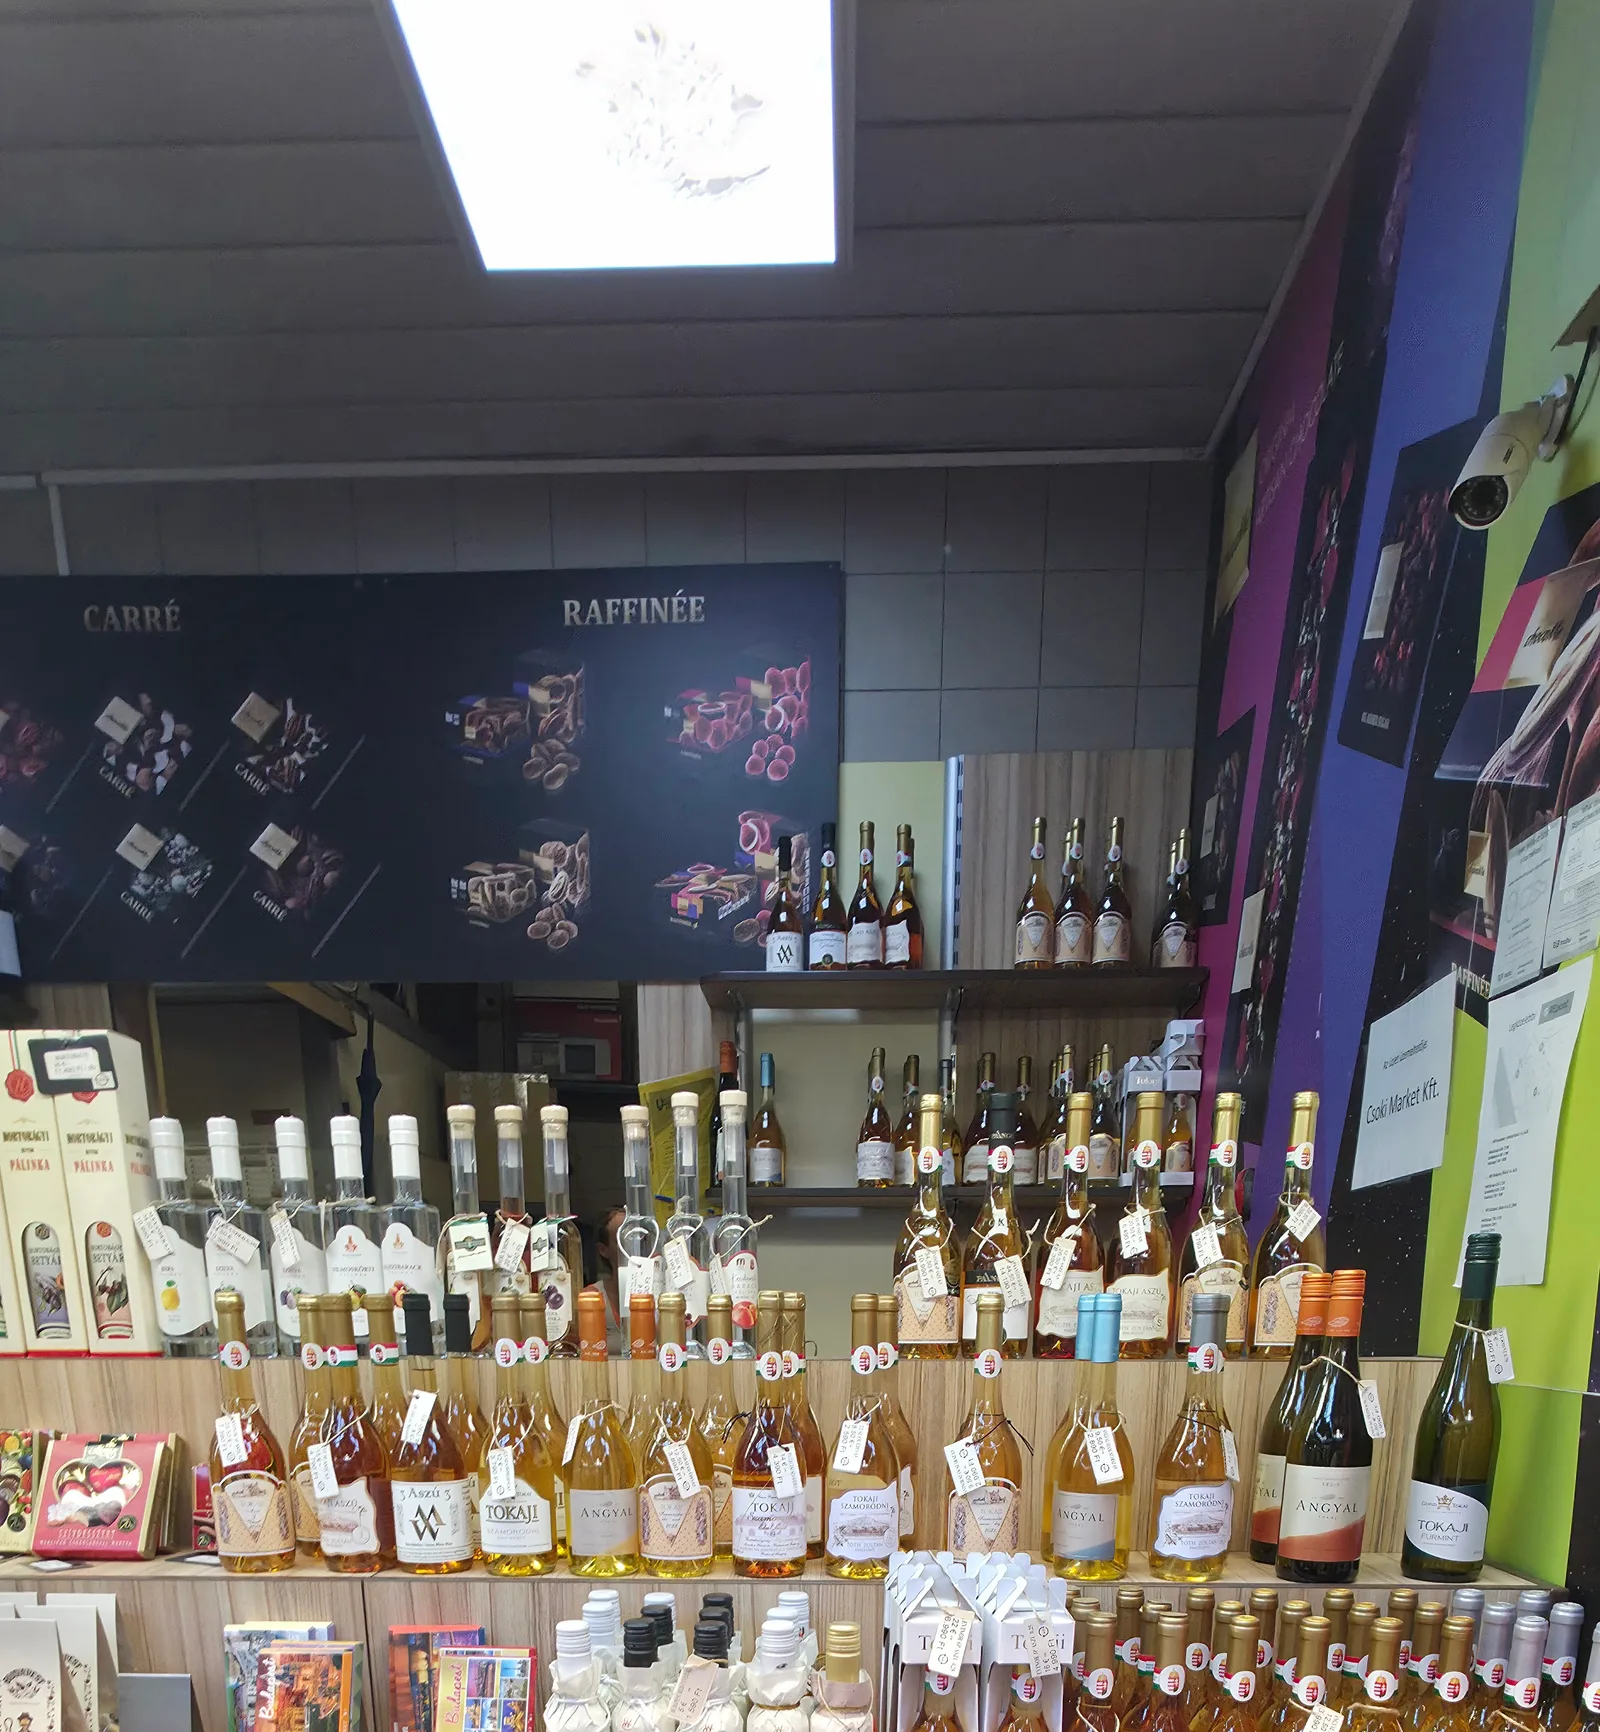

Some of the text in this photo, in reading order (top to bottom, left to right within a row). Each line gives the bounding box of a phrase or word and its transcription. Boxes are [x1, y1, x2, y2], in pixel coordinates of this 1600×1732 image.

[563, 588, 705, 626] RAFFINÉE
[83, 598, 182, 633] CARRÉ
[1366, 1077, 1439, 1124] Csoki Market Kft.
[408, 1486, 441, 1499] Aszú
[853, 1495, 878, 1503] TOKAJI
[1189, 1492, 1215, 1501] TOKAJI
[580, 1507, 633, 1518] ANGYAL
[752, 1502, 794, 1516] TOKAJI
[1296, 1500, 1358, 1513] ANGYAL
[486, 1504, 539, 1524] TOKAJI
[1057, 1508, 1105, 1523] ANGYAL
[1417, 1519, 1468, 1532] TOKAJI
[1421, 1532, 1460, 1542] FURMINT
[258, 1657, 276, 1719] Budapest
[445, 1662, 466, 1724] Budapest
